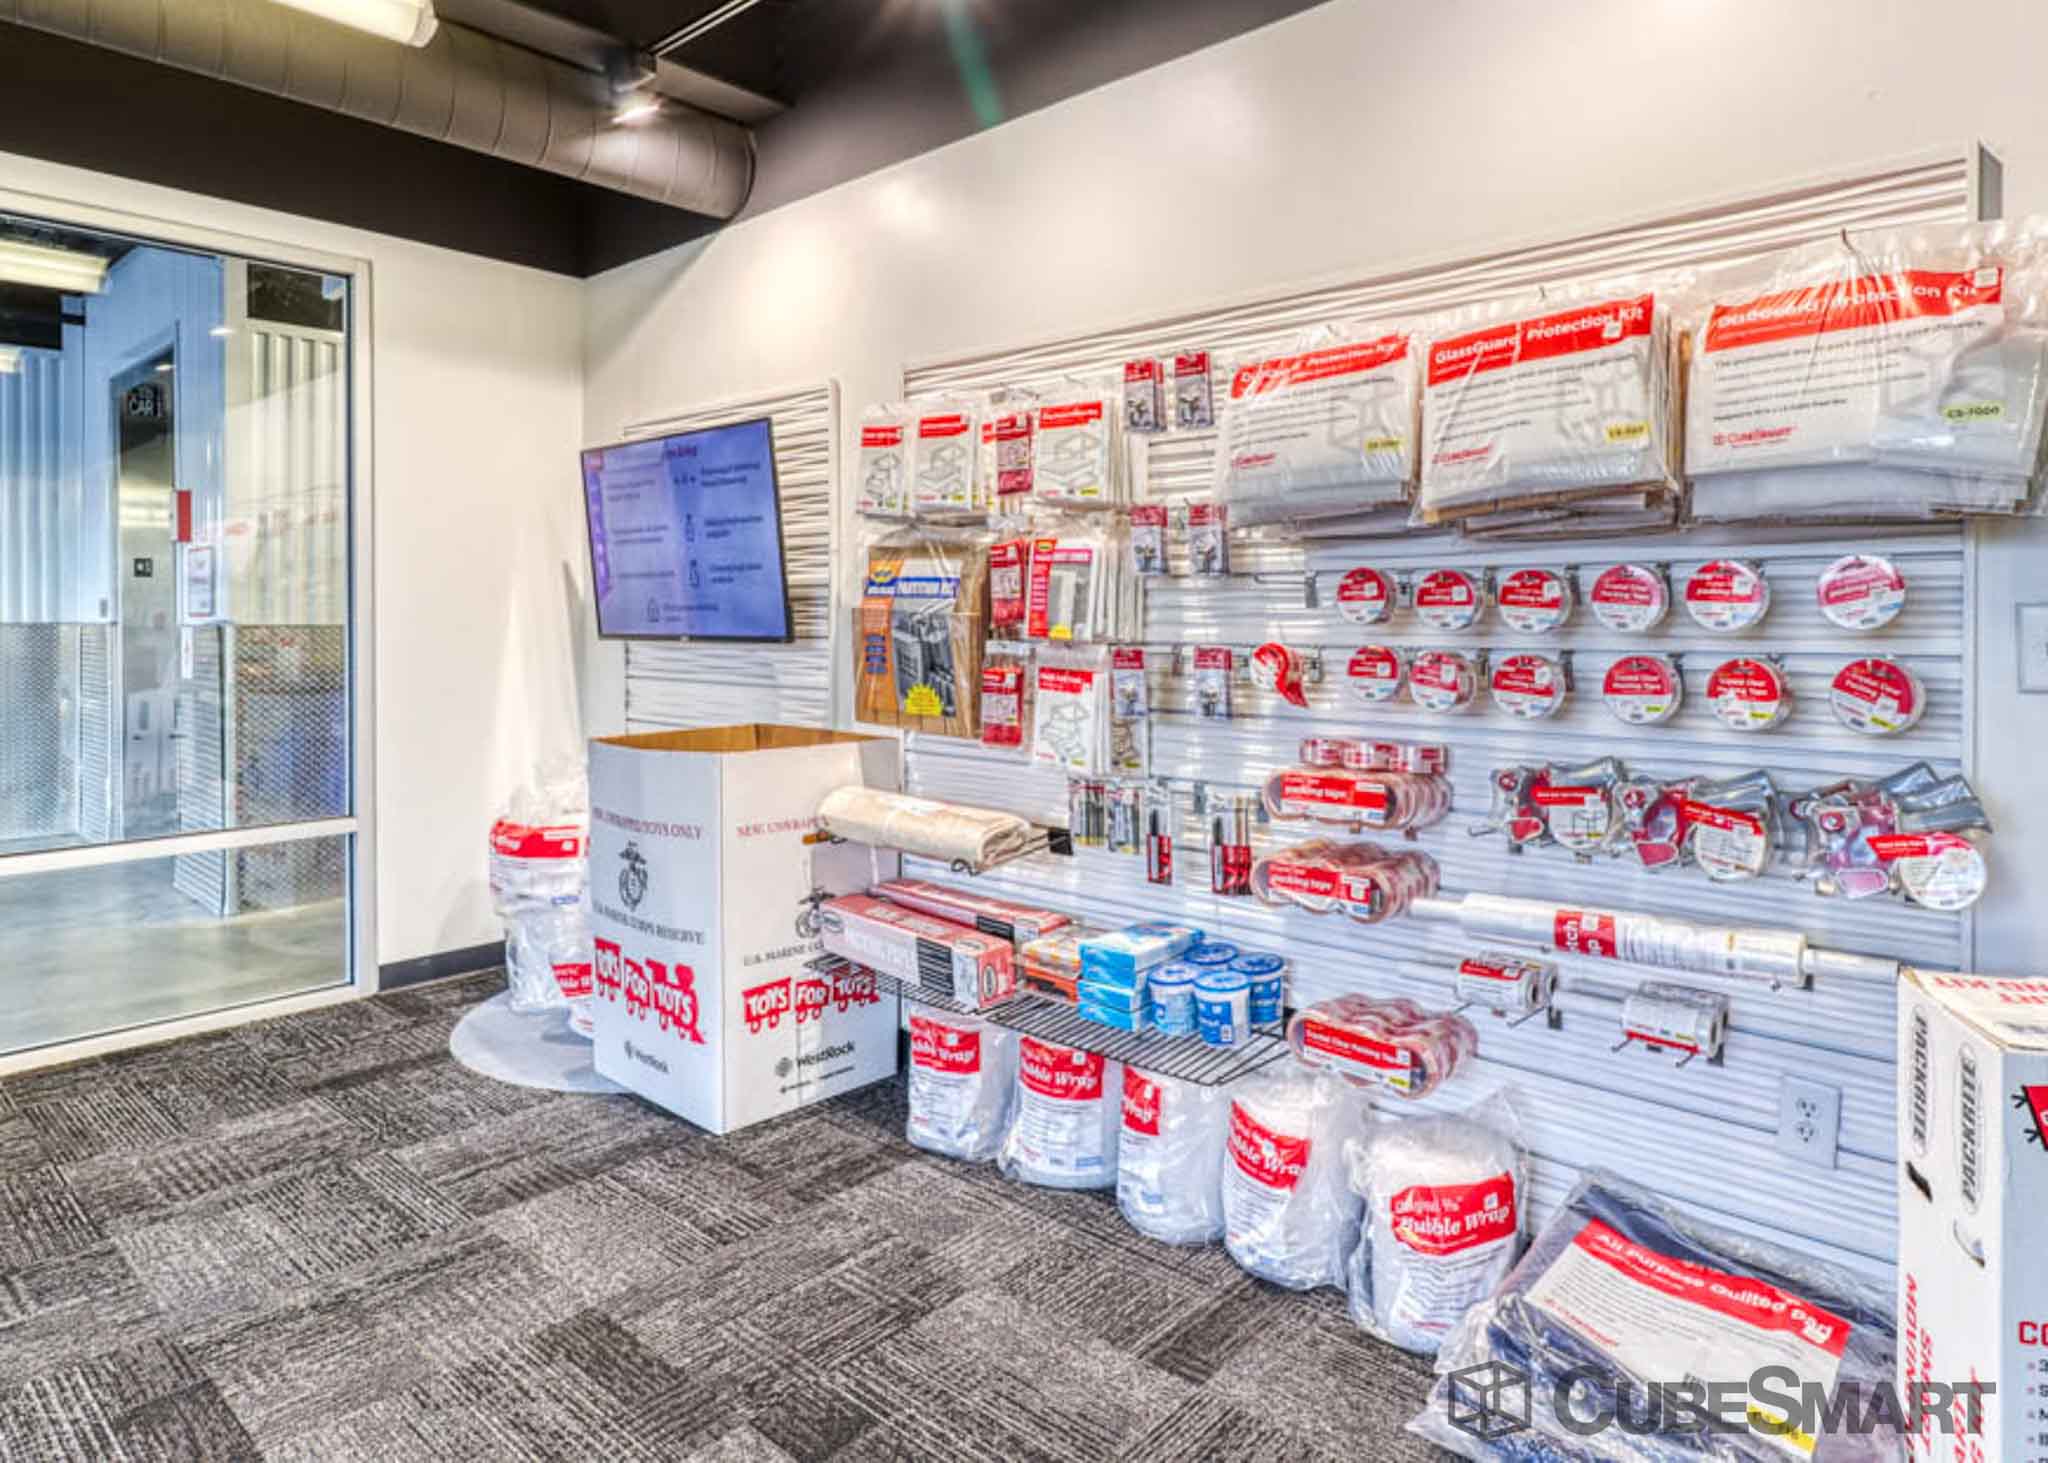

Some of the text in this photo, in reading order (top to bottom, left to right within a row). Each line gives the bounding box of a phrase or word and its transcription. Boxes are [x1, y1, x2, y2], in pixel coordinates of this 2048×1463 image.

[1527, 312, 1614, 342] Protection
[1619, 306, 1645, 321] Kit
[654, 982, 693, 1025] TOTS
[746, 986, 788, 1016] TOYS
[796, 984, 828, 1006] FOR
[1054, 1069, 1097, 1091] Wrap
[1959, 1055, 1977, 1205] PACKRITE
[1263, 1154, 1301, 1177] Wra
[1400, 1204, 1511, 1236] Bubble Wrap
[1627, 1246, 1706, 1289] Purpose
[1709, 1281, 1788, 1313] Quilted
